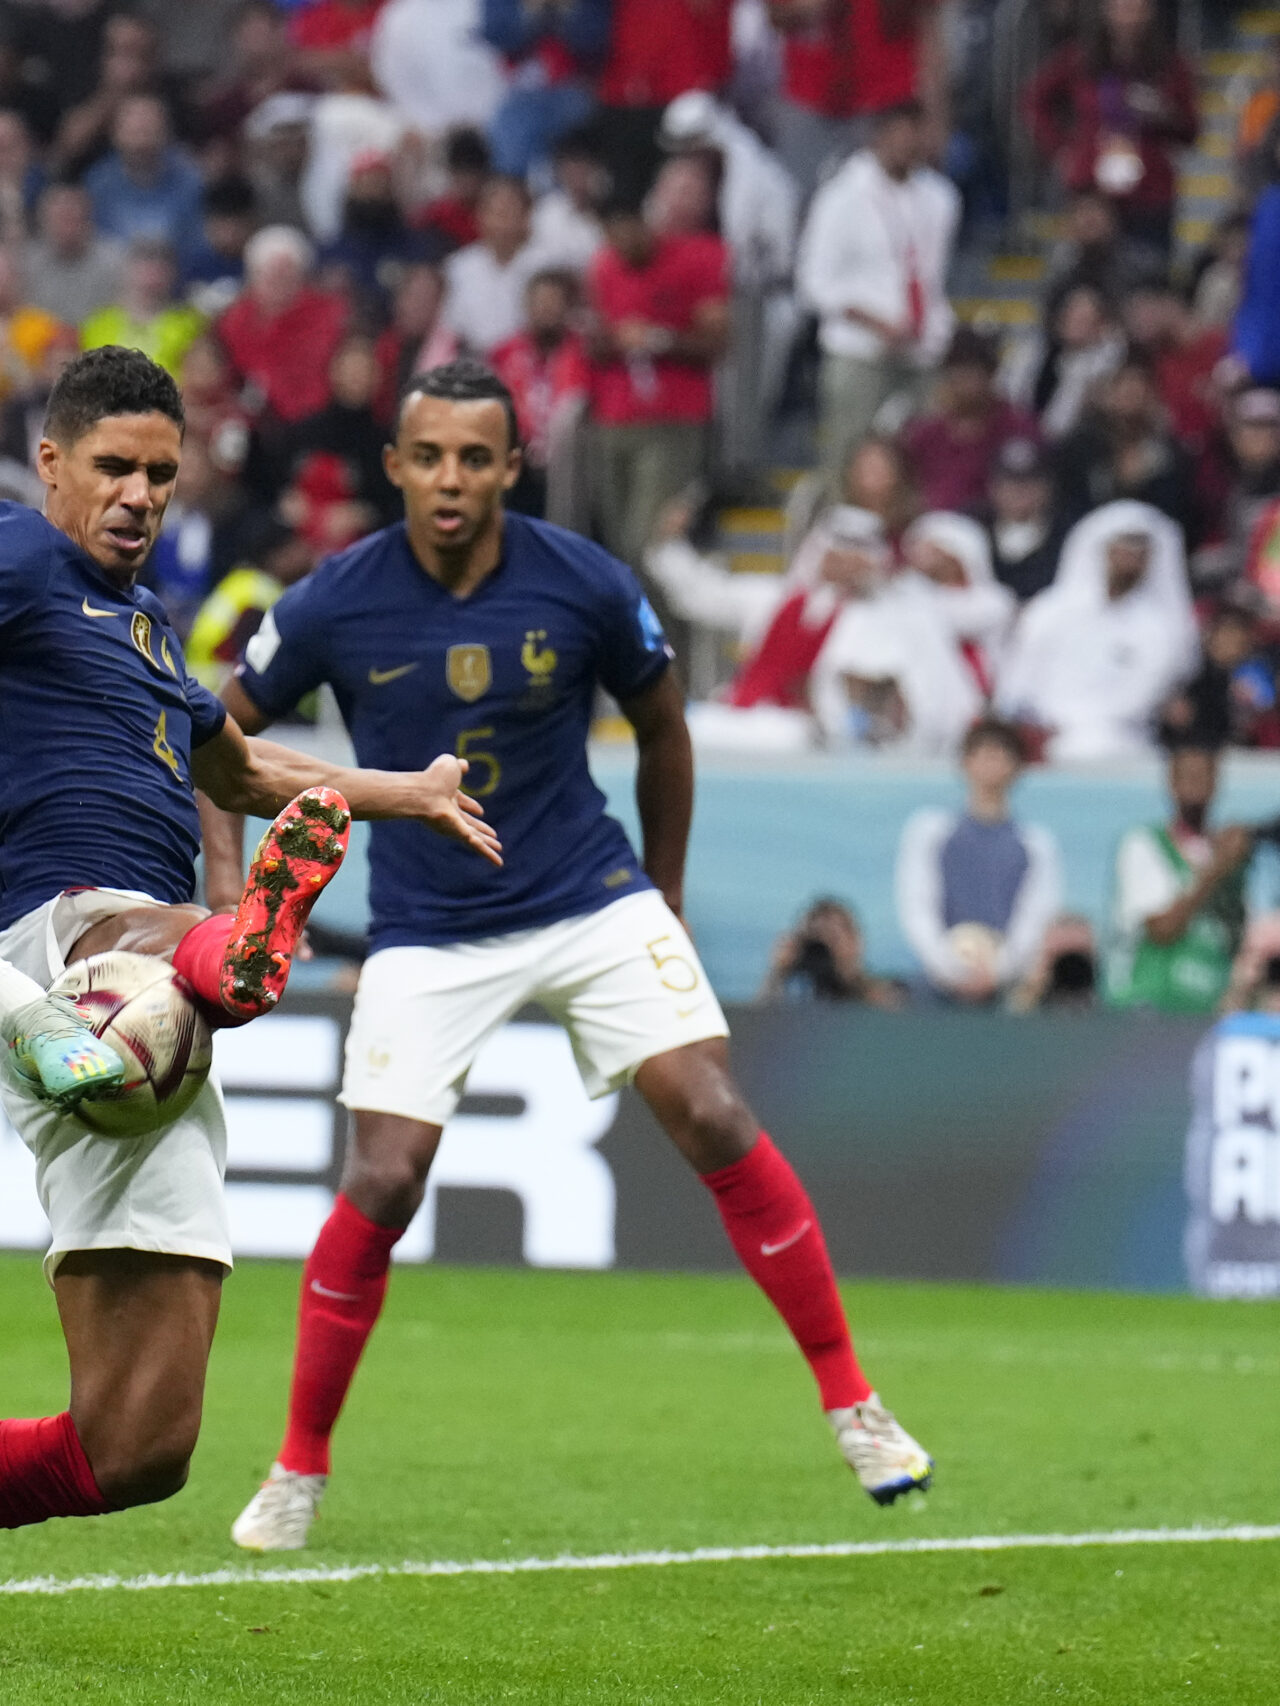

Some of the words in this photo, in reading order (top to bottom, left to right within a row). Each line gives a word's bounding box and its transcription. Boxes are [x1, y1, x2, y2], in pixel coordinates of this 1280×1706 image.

[153, 709, 184, 782] 4
[455, 726, 501, 797] 5
[646, 934, 699, 992] 5
